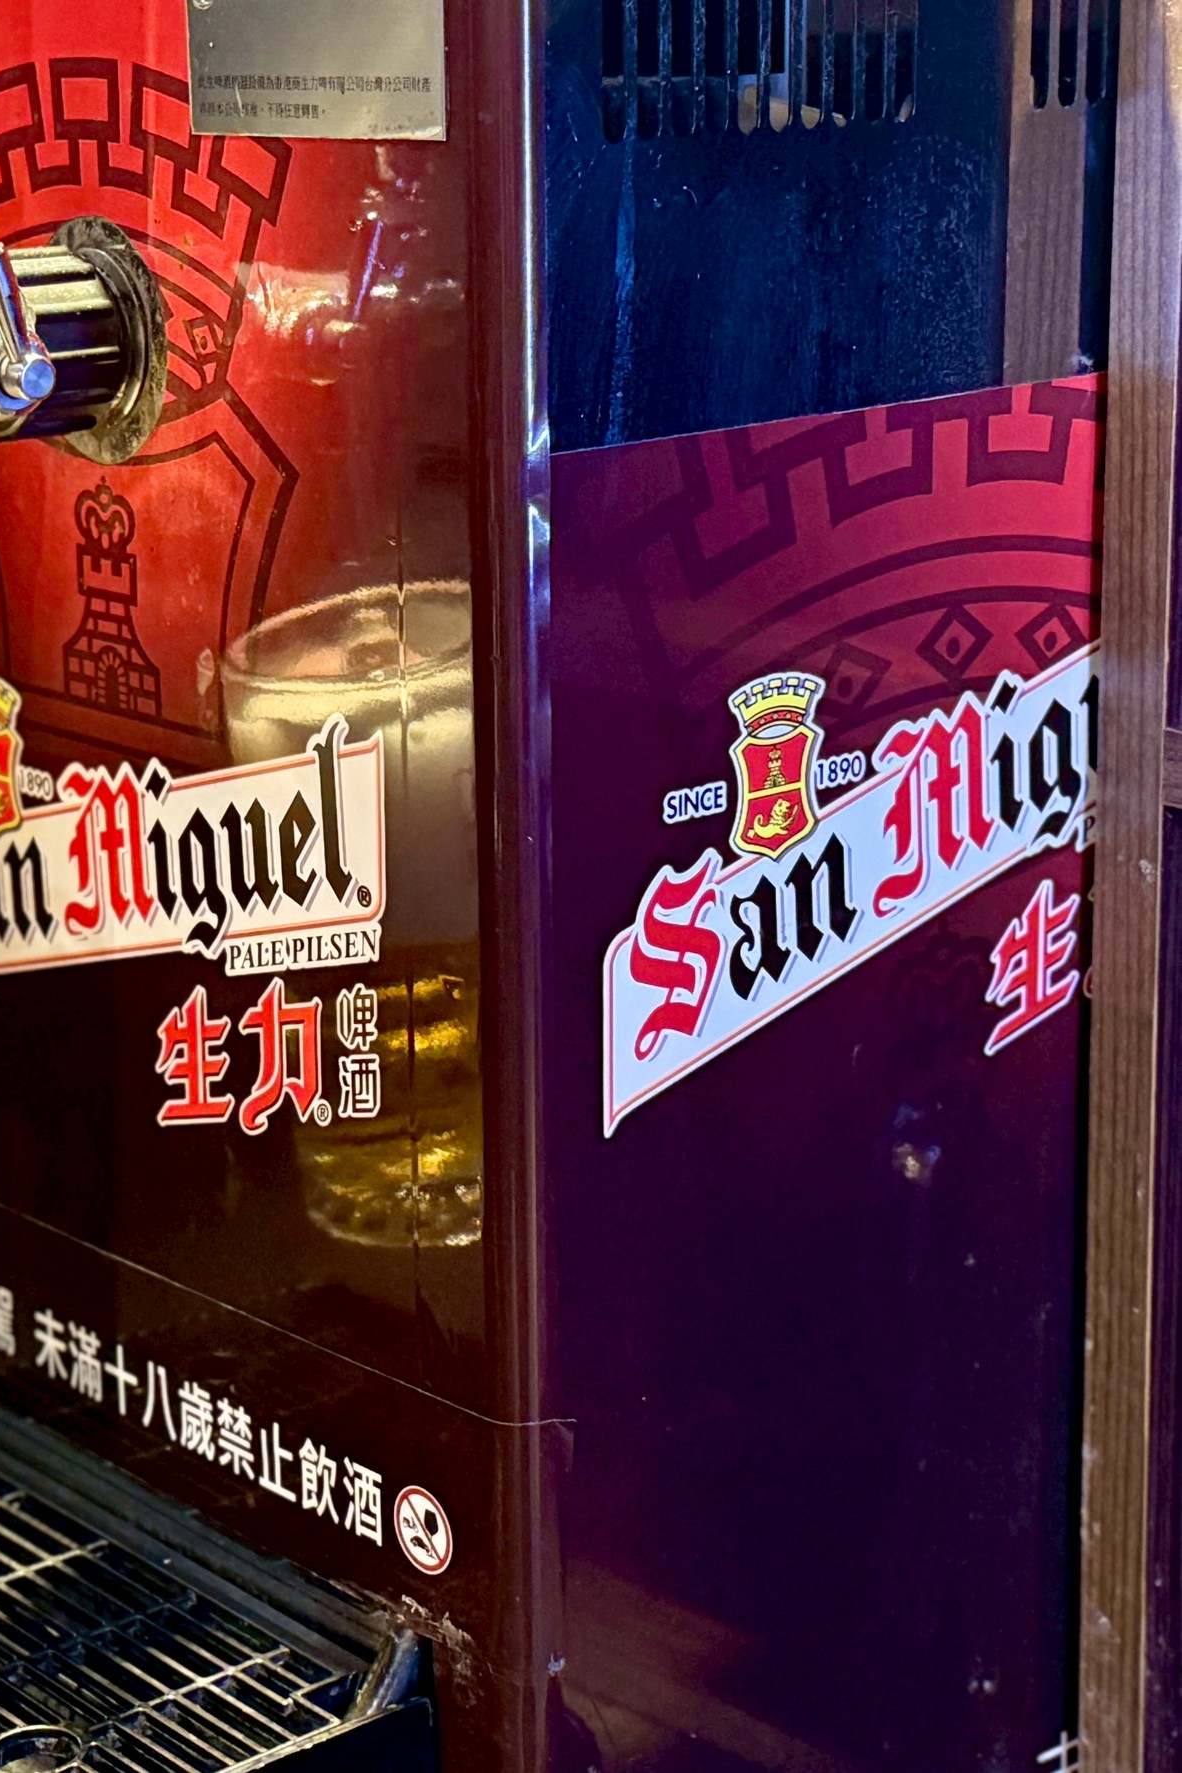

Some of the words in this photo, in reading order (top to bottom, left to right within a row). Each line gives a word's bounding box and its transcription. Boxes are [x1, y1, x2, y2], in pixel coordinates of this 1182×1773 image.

[20, 769, 51, 797] 1890
[64, 721, 353, 950] Miguel
[667, 787, 724, 819] SINCE
[816, 757, 861, 787] 1890
[229, 939, 285, 970] PALE
[292, 929, 378, 964] PILSEN
[630, 833, 857, 1062] San
[158, 980, 320, 1132] 生力
[337, 985, 380, 1116] 啤酒
[33, 1307, 384, 1548] 未滿十八歲禁止飲酒
